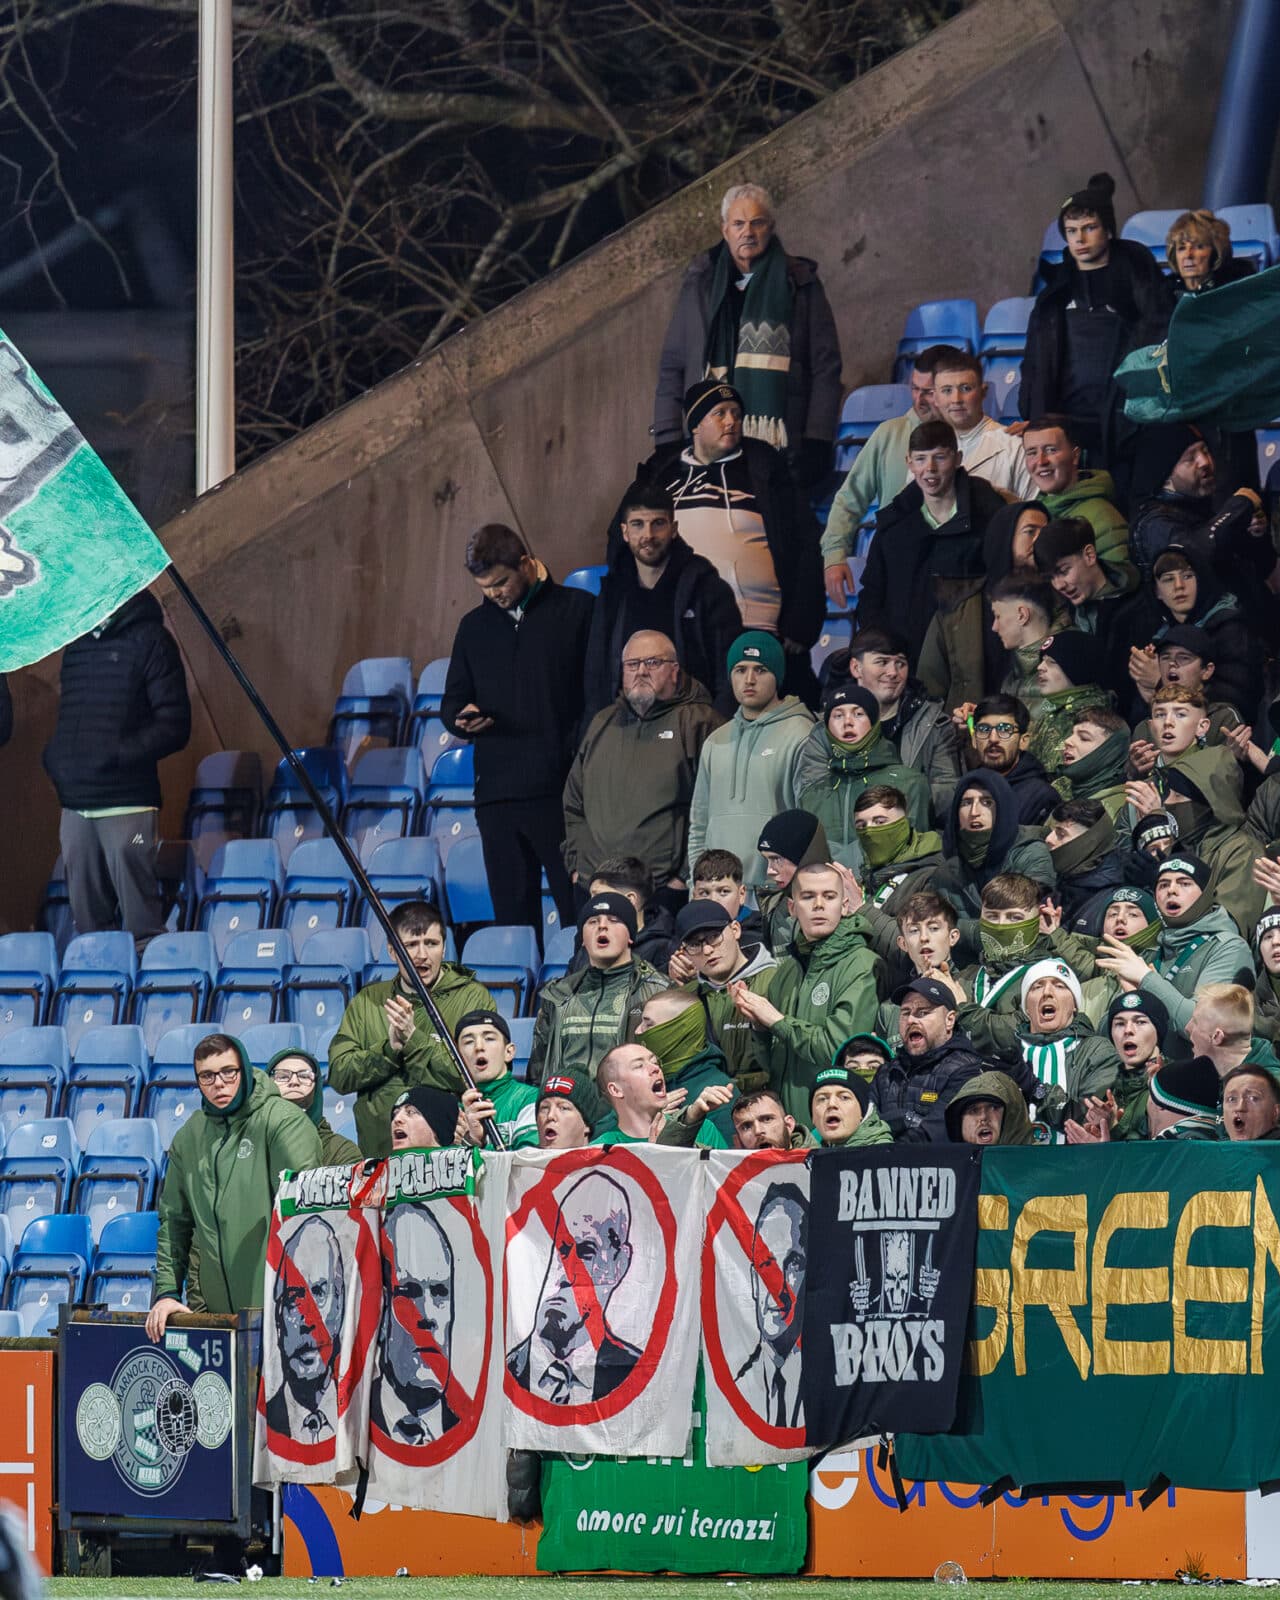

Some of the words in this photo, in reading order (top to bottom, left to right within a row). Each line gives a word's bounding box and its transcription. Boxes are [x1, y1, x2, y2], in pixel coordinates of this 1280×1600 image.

[837, 1167, 956, 1222] BANNED
[201, 1339, 223, 1367] 15
[830, 1319, 945, 1387] BHOYS
[576, 1509, 647, 1533] amore
[652, 1507, 686, 1536] sui
[690, 1508, 778, 1541] terrazzi
